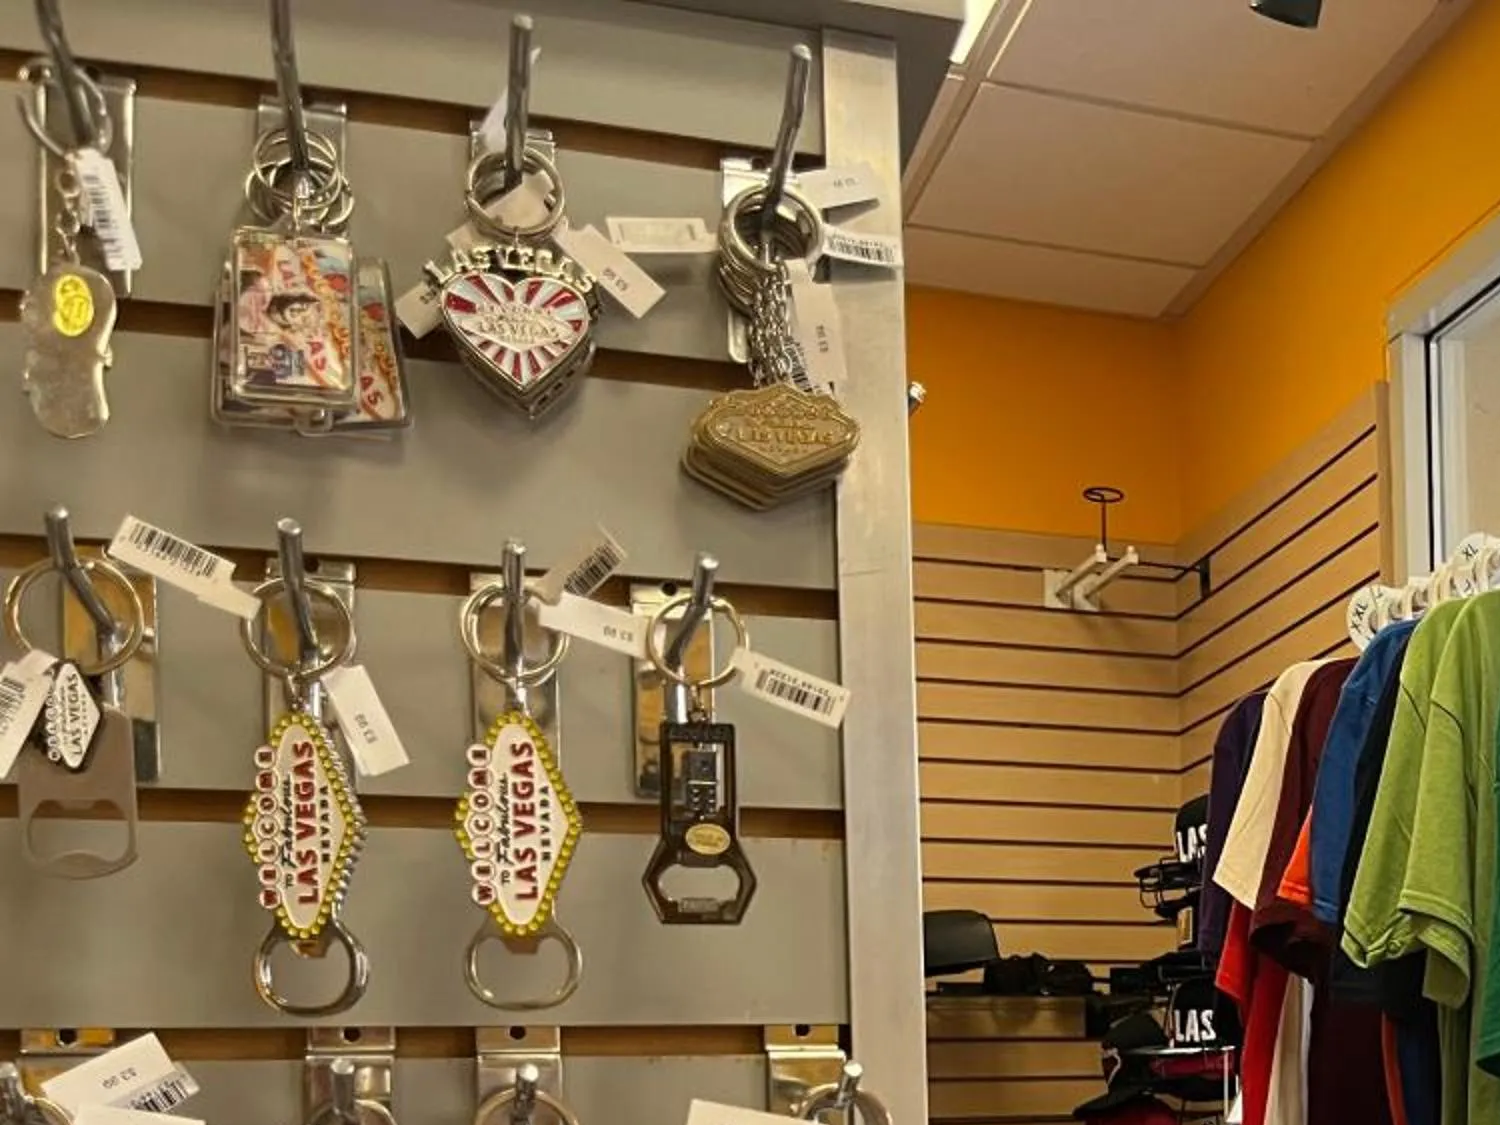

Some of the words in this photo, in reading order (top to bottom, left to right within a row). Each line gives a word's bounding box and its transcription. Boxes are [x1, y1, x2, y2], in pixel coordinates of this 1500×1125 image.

[293, 741, 317, 841] VEGAS
[469, 746, 494, 903] WELCOME
[511, 741, 537, 838] VEGAS
[296, 848, 319, 904] LAS
[515, 847, 539, 900] LAS
[1175, 1009, 1216, 1042] LAS
